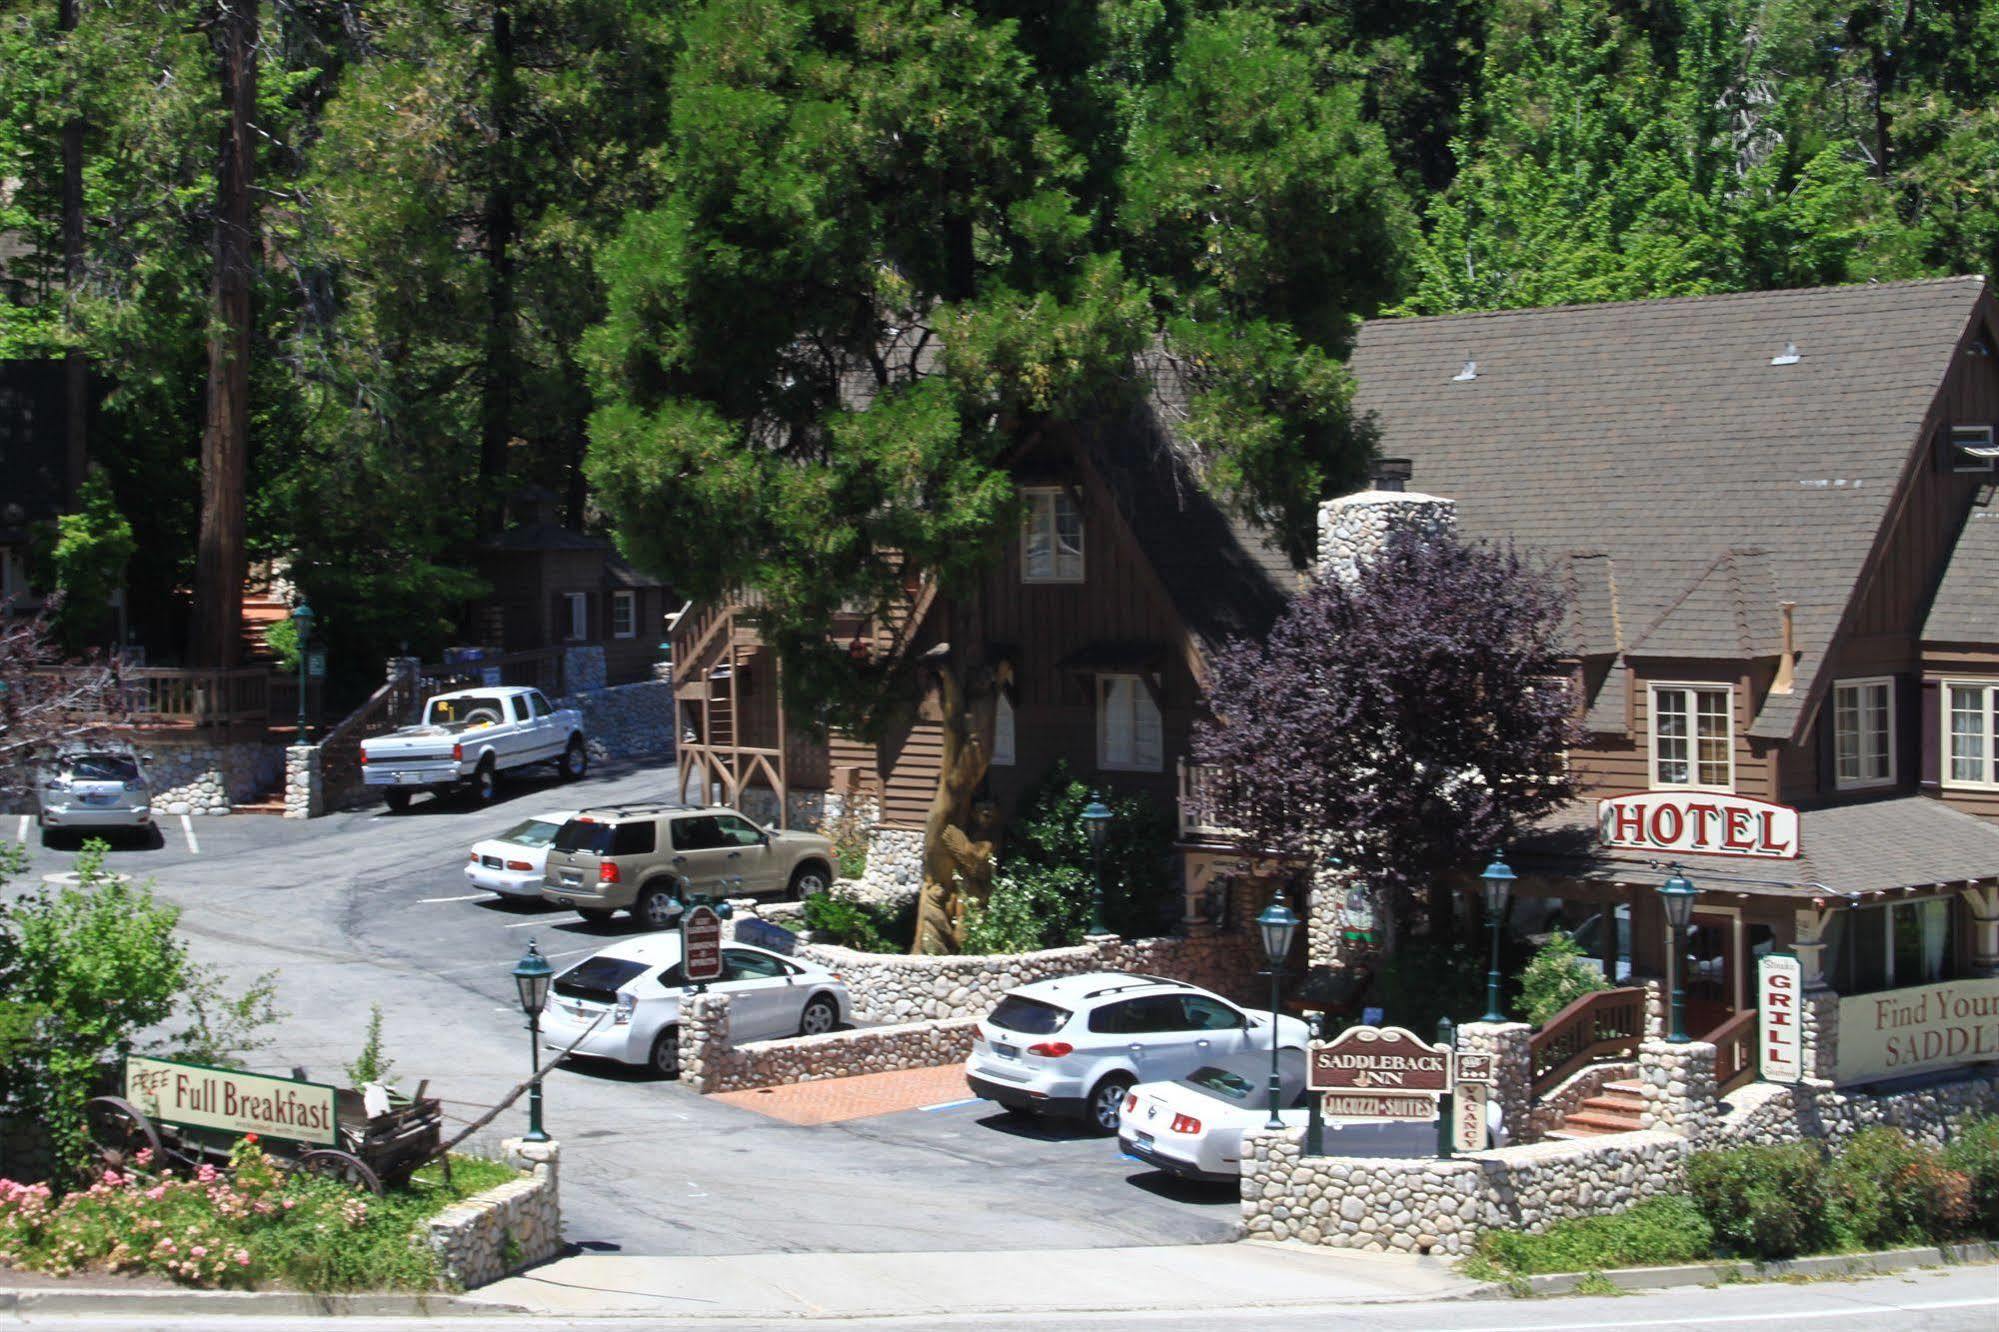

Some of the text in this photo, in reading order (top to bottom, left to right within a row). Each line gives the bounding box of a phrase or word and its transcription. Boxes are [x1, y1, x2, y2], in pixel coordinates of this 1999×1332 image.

[1608, 802, 1790, 855] HOTEL
[1768, 974, 1791, 1064] GRILL
[1875, 989, 1999, 1030] Find Your
[1318, 1054, 1444, 1071] SADDLEBACK
[1885, 1023, 1999, 1067] SADDL
[131, 1069, 171, 1091] FREE
[1353, 1070, 1404, 1087] INN
[176, 1074, 330, 1130] Full Breakfast
[1326, 1097, 1432, 1117] JACUZZI SUITES
[1464, 1085, 1477, 1148] VACANCY
